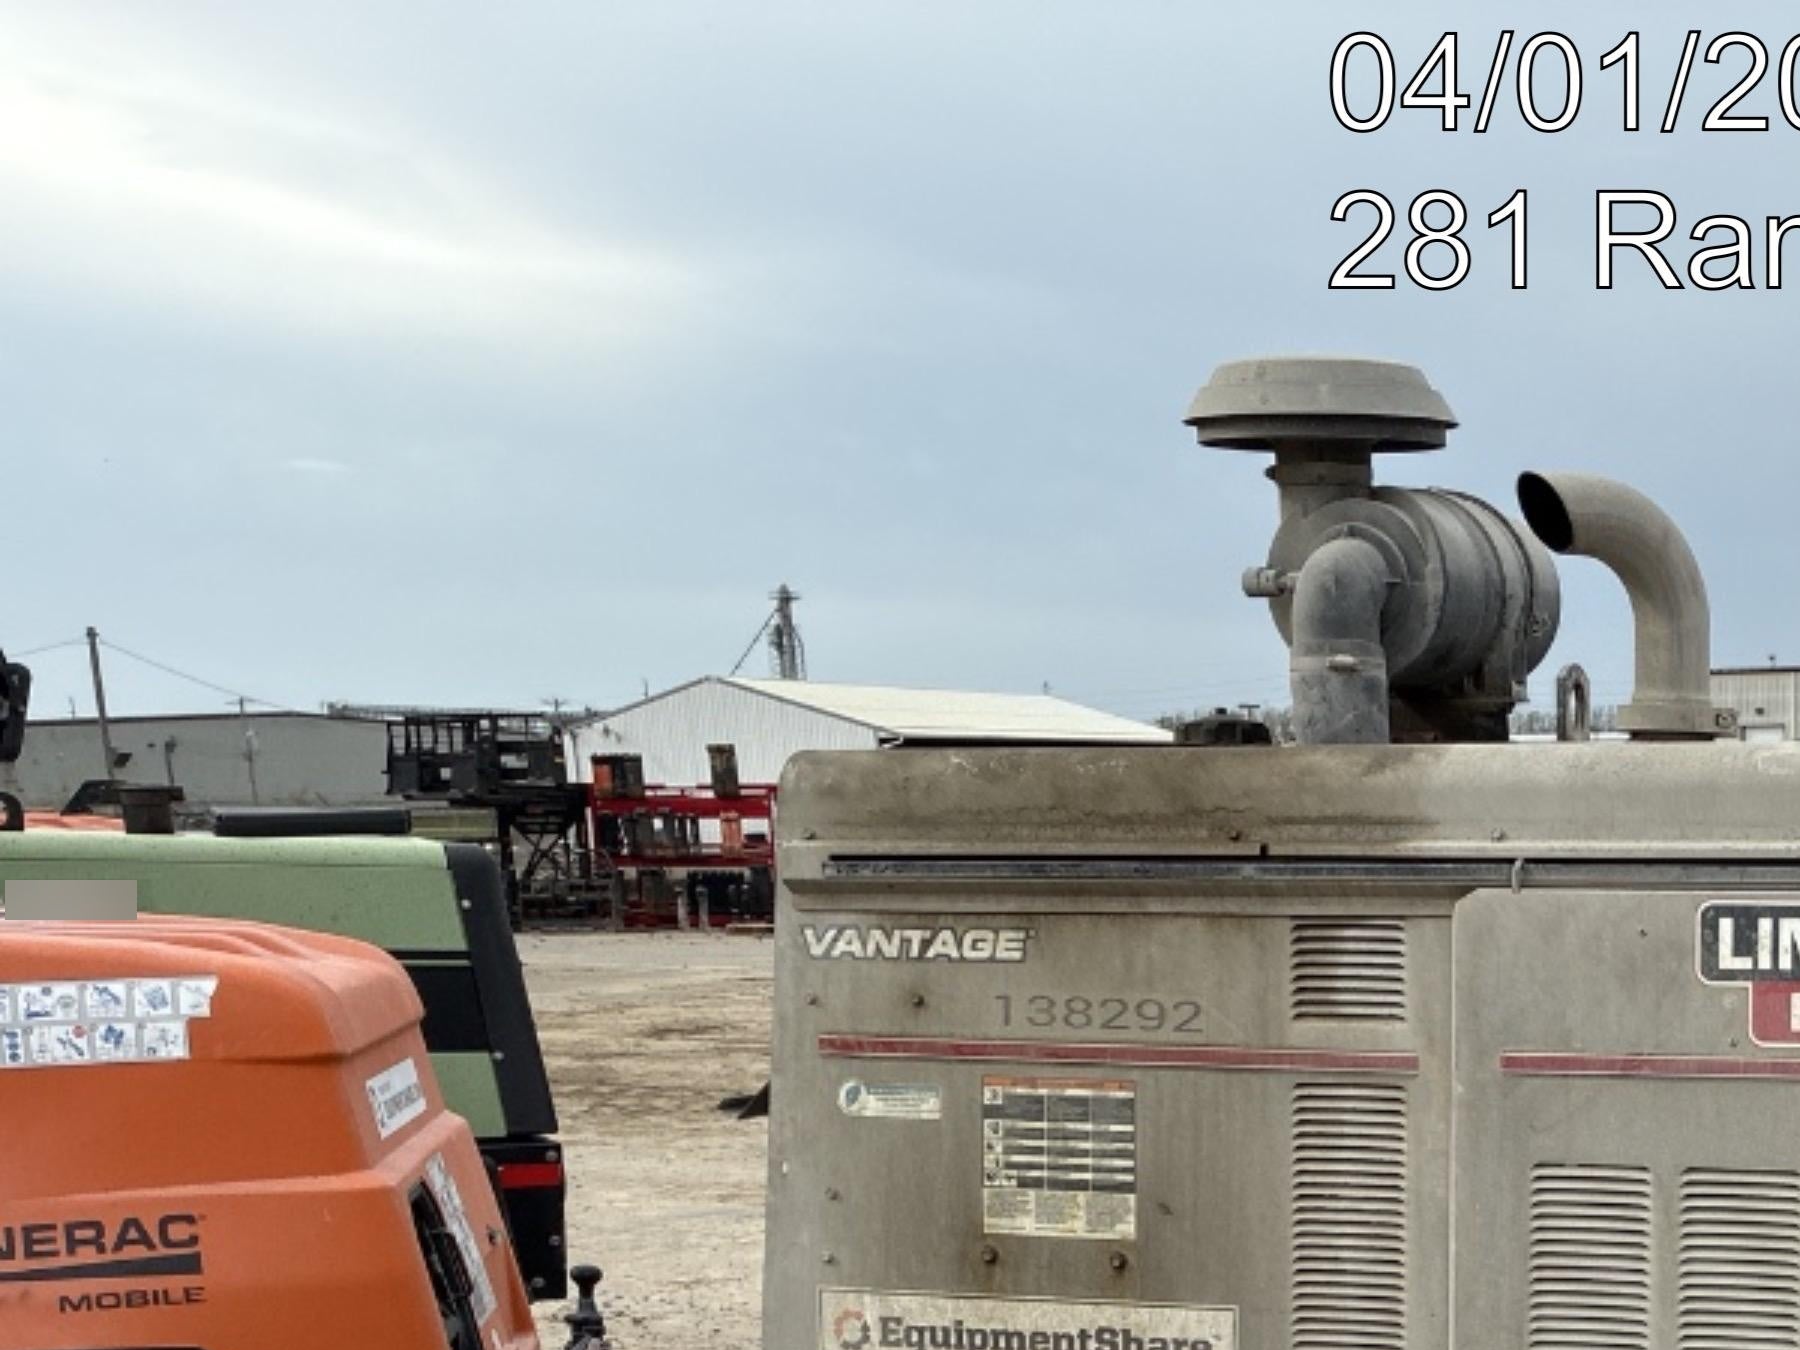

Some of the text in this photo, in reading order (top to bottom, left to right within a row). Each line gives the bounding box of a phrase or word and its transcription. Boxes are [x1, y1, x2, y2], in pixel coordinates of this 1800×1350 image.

[802, 925, 1029, 962] VANTAGE
[994, 995, 1203, 1033] 138292
[58, 1287, 207, 1314] MOBILE
